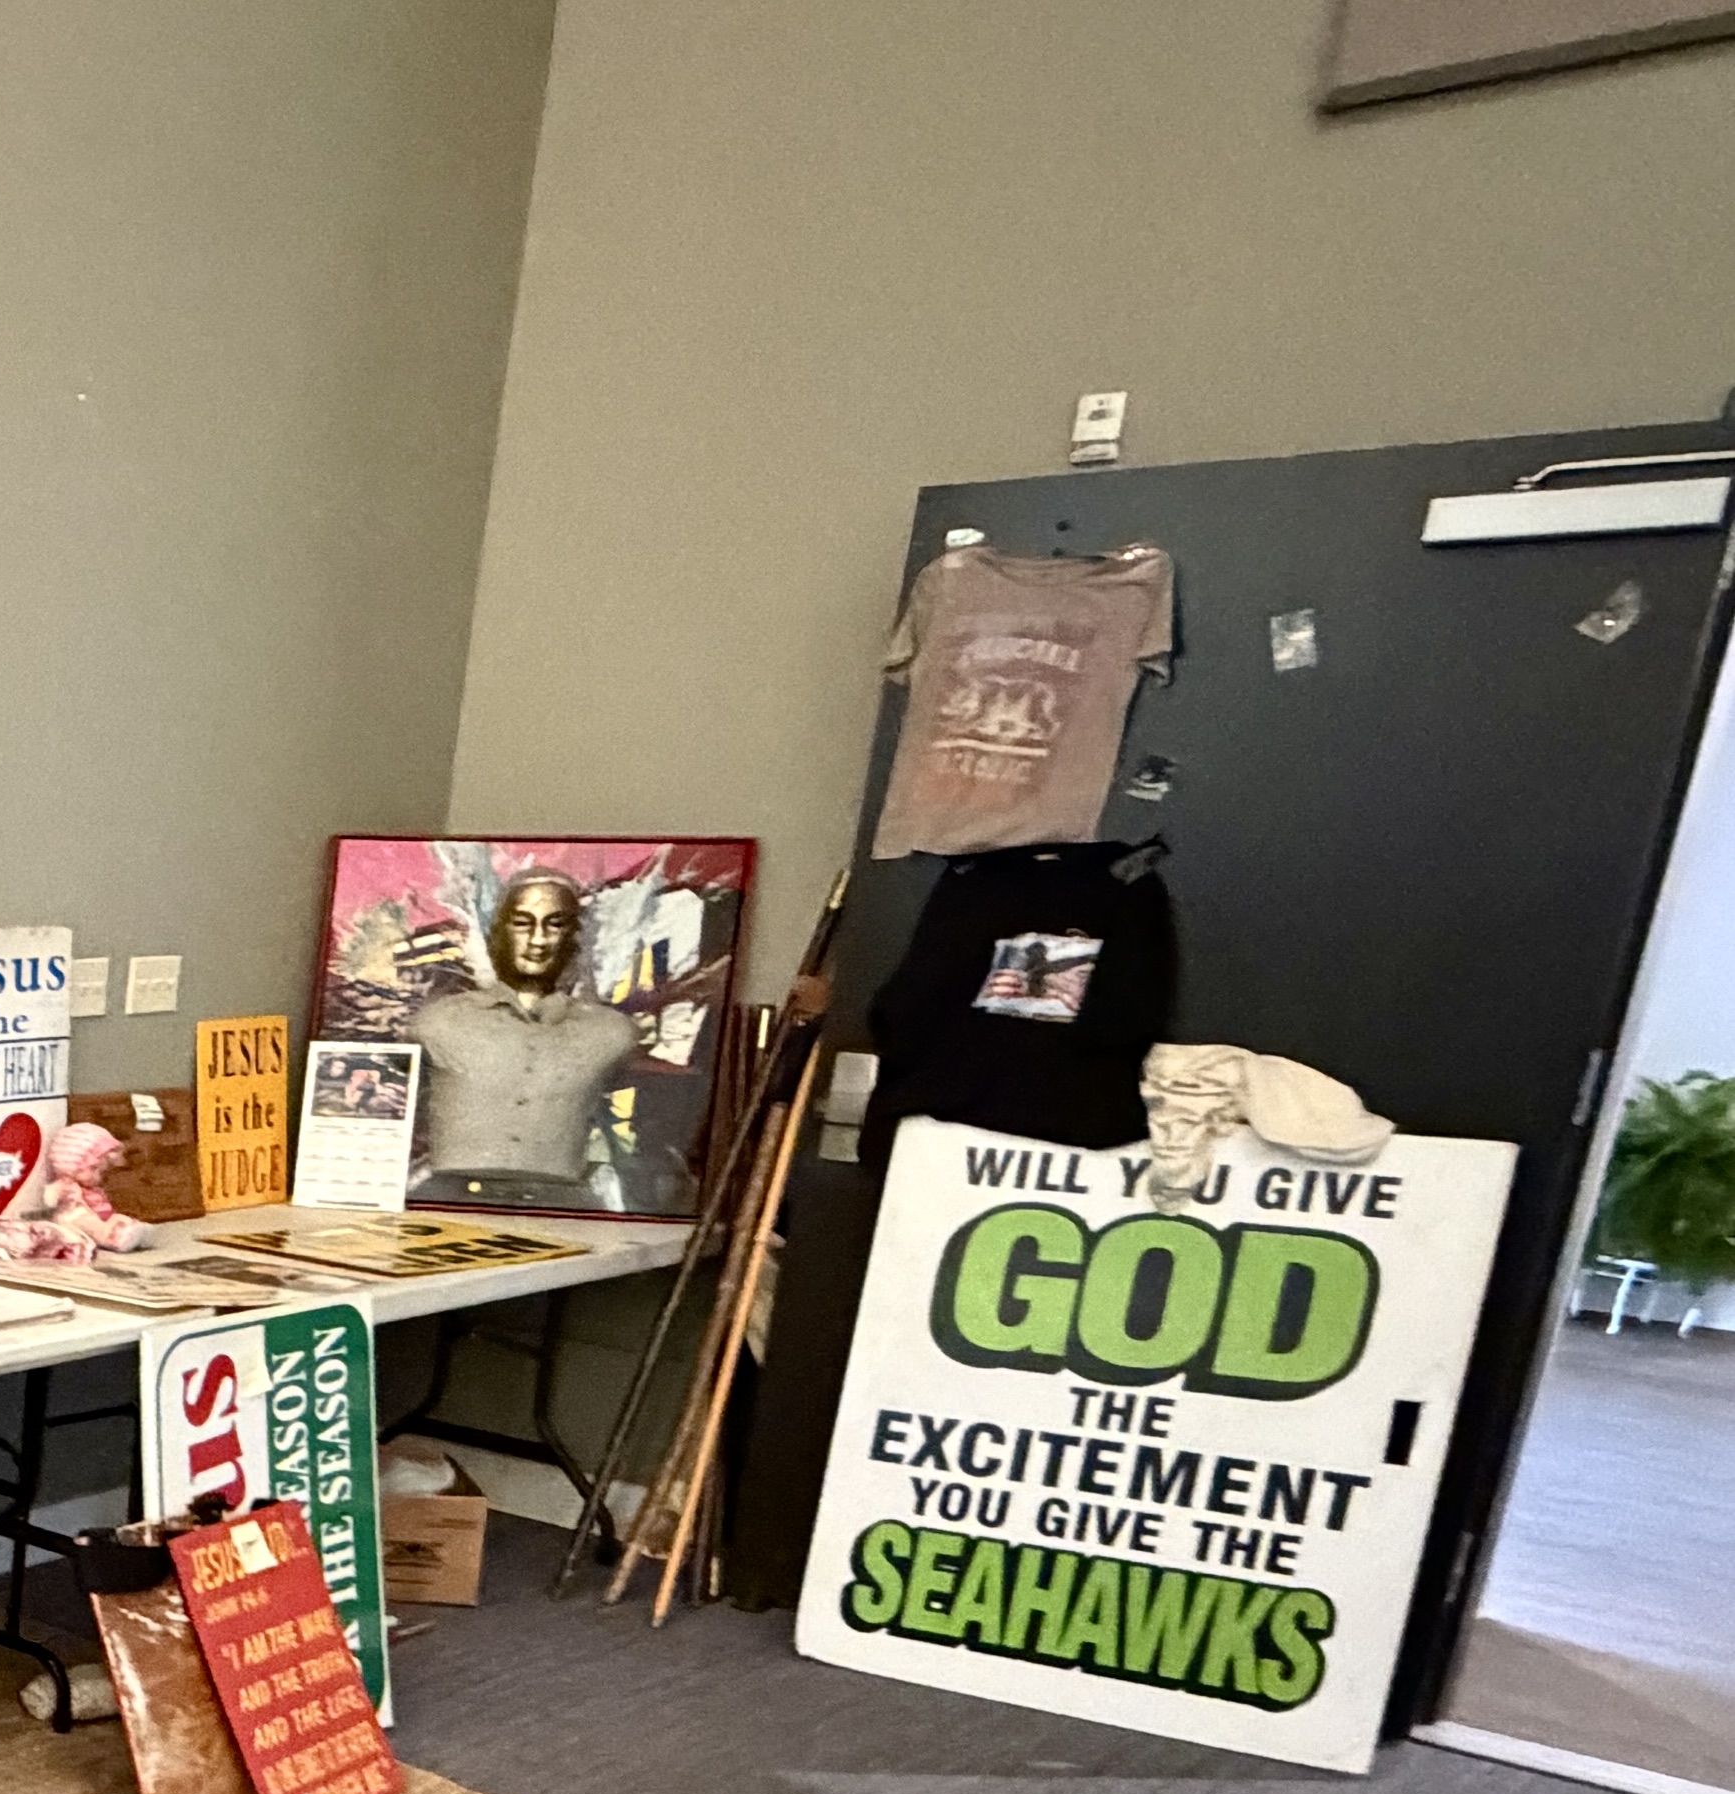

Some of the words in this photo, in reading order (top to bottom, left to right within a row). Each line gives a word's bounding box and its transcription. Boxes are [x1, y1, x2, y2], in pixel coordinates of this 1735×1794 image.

[4, 1044, 59, 1096] HEART
[207, 1027, 283, 1079] JESUS
[214, 1095, 233, 1133] is
[242, 1092, 276, 1130] the
[206, 1144, 282, 1200] JUDGE
[965, 1146, 1089, 1194] WILL
[1119, 1157, 1229, 1206] YU
[1256, 1166, 1405, 1220] GIVE
[927, 1201, 1381, 1401] GOD
[272, 1350, 313, 1531] EASON
[313, 1324, 356, 1508] SEASON
[1069, 1387, 1175, 1439] THE
[869, 1410, 1371, 1532] EXCITEMENT
[910, 1476, 1010, 1529] YOU
[1035, 1498, 1162, 1554] GIVE
[1193, 1520, 1302, 1576] THE
[841, 1519, 1335, 1712] SEAHAWKS
[242, 1631, 270, 1665] AM
[238, 1679, 273, 1713] AND
[253, 1716, 291, 1755] AND
[289, 1699, 328, 1736] THE
